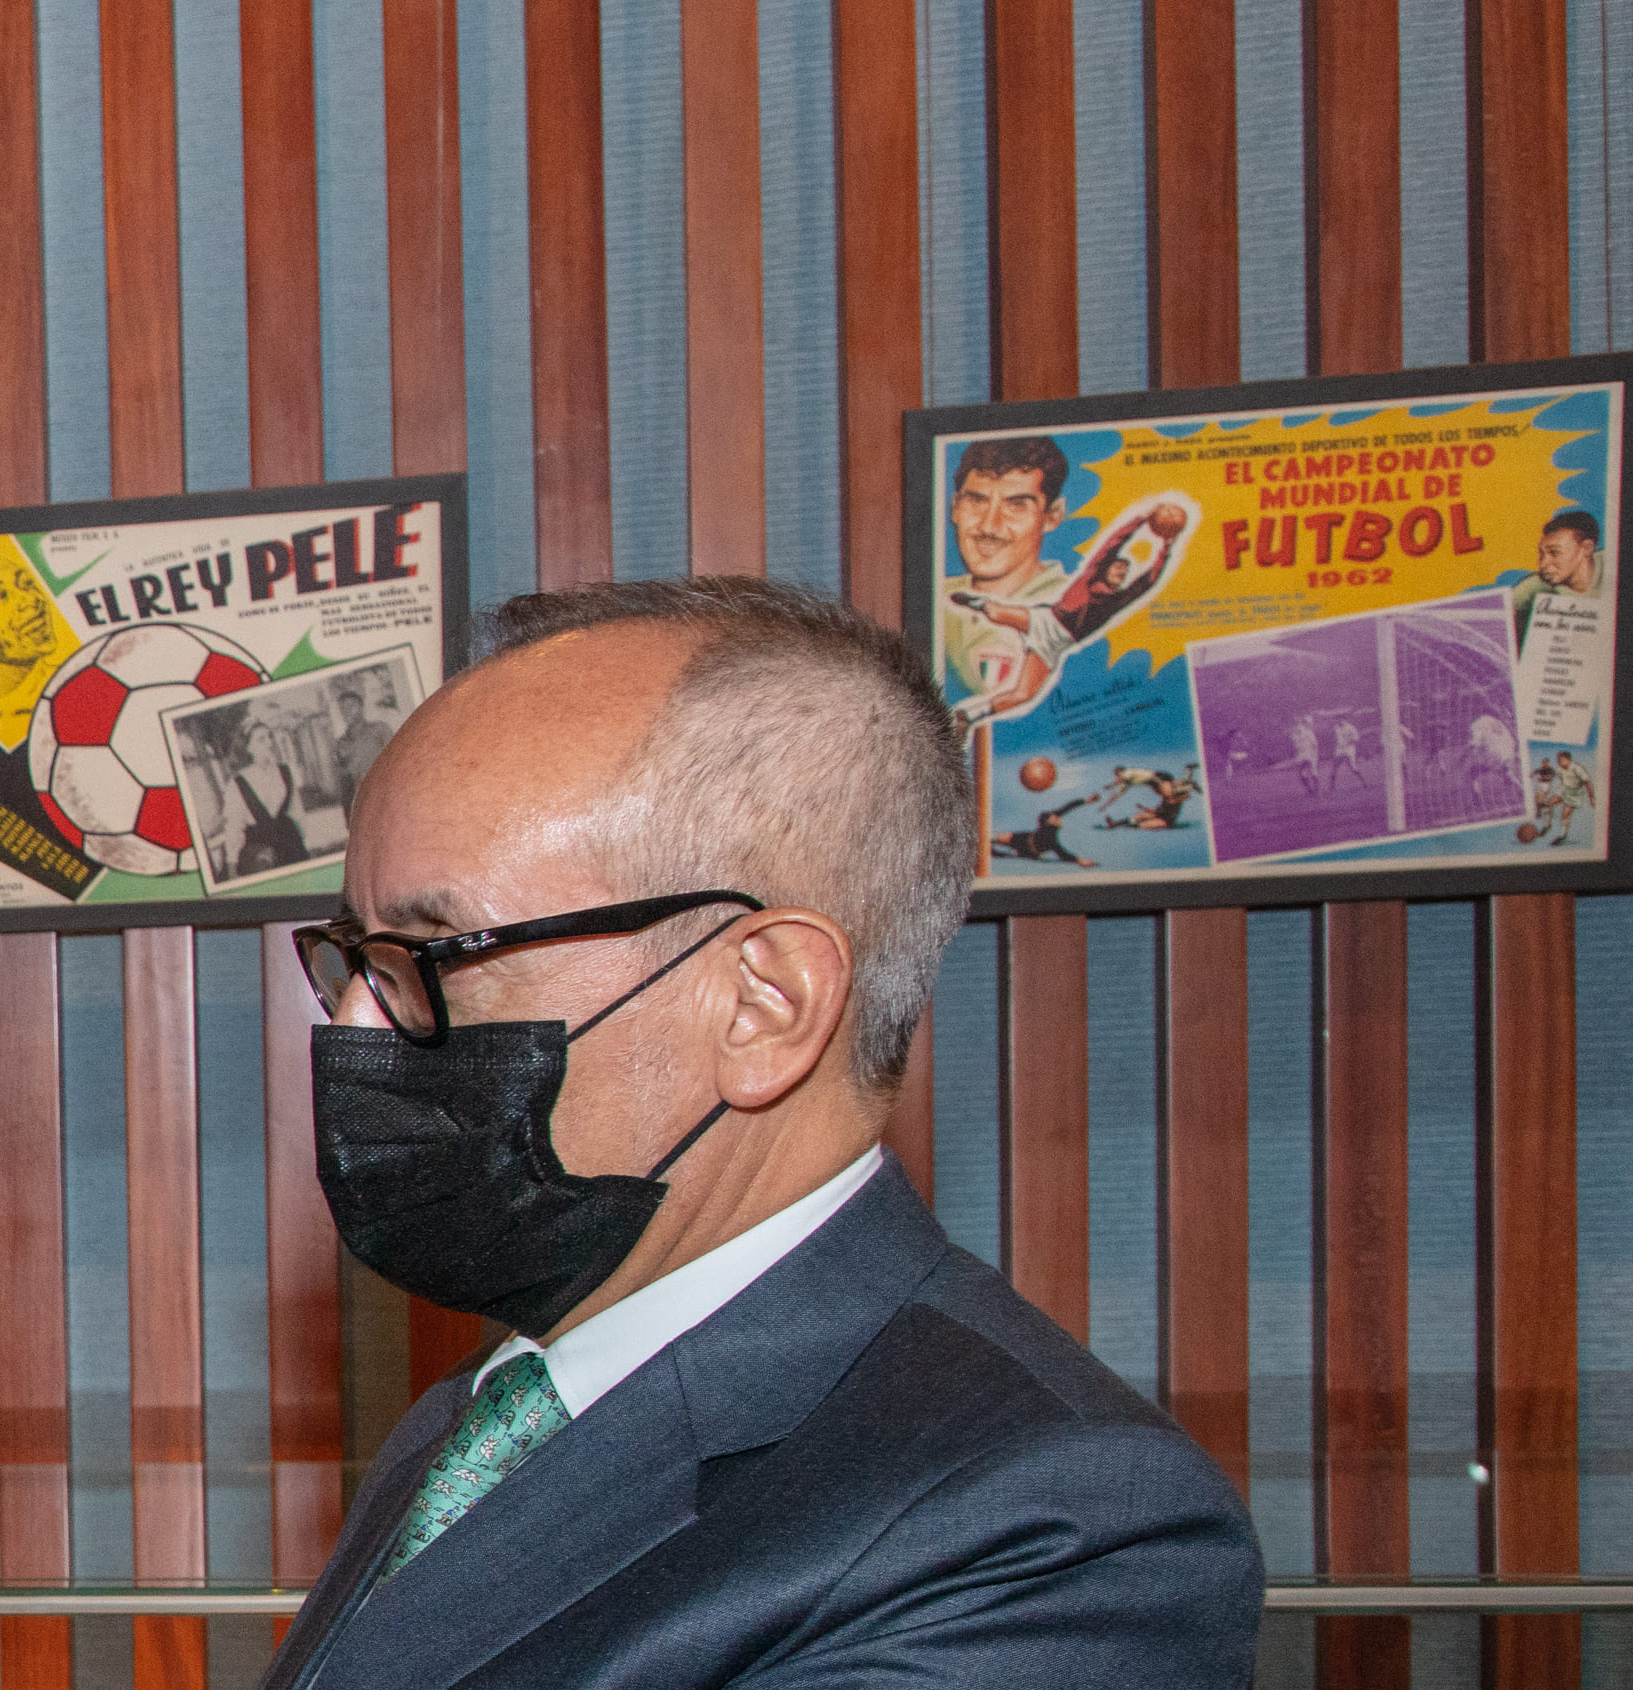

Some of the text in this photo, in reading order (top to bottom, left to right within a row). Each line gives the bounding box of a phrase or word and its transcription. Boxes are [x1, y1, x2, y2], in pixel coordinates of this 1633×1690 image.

[1224, 442, 1496, 485] EL CAMPEONATO
[1259, 472, 1463, 510] MUNDIAL DE
[1221, 501, 1485, 571] FUTBOL
[75, 583, 131, 627] EL
[130, 551, 233, 619] REY
[1306, 567, 1394, 589] 1962
